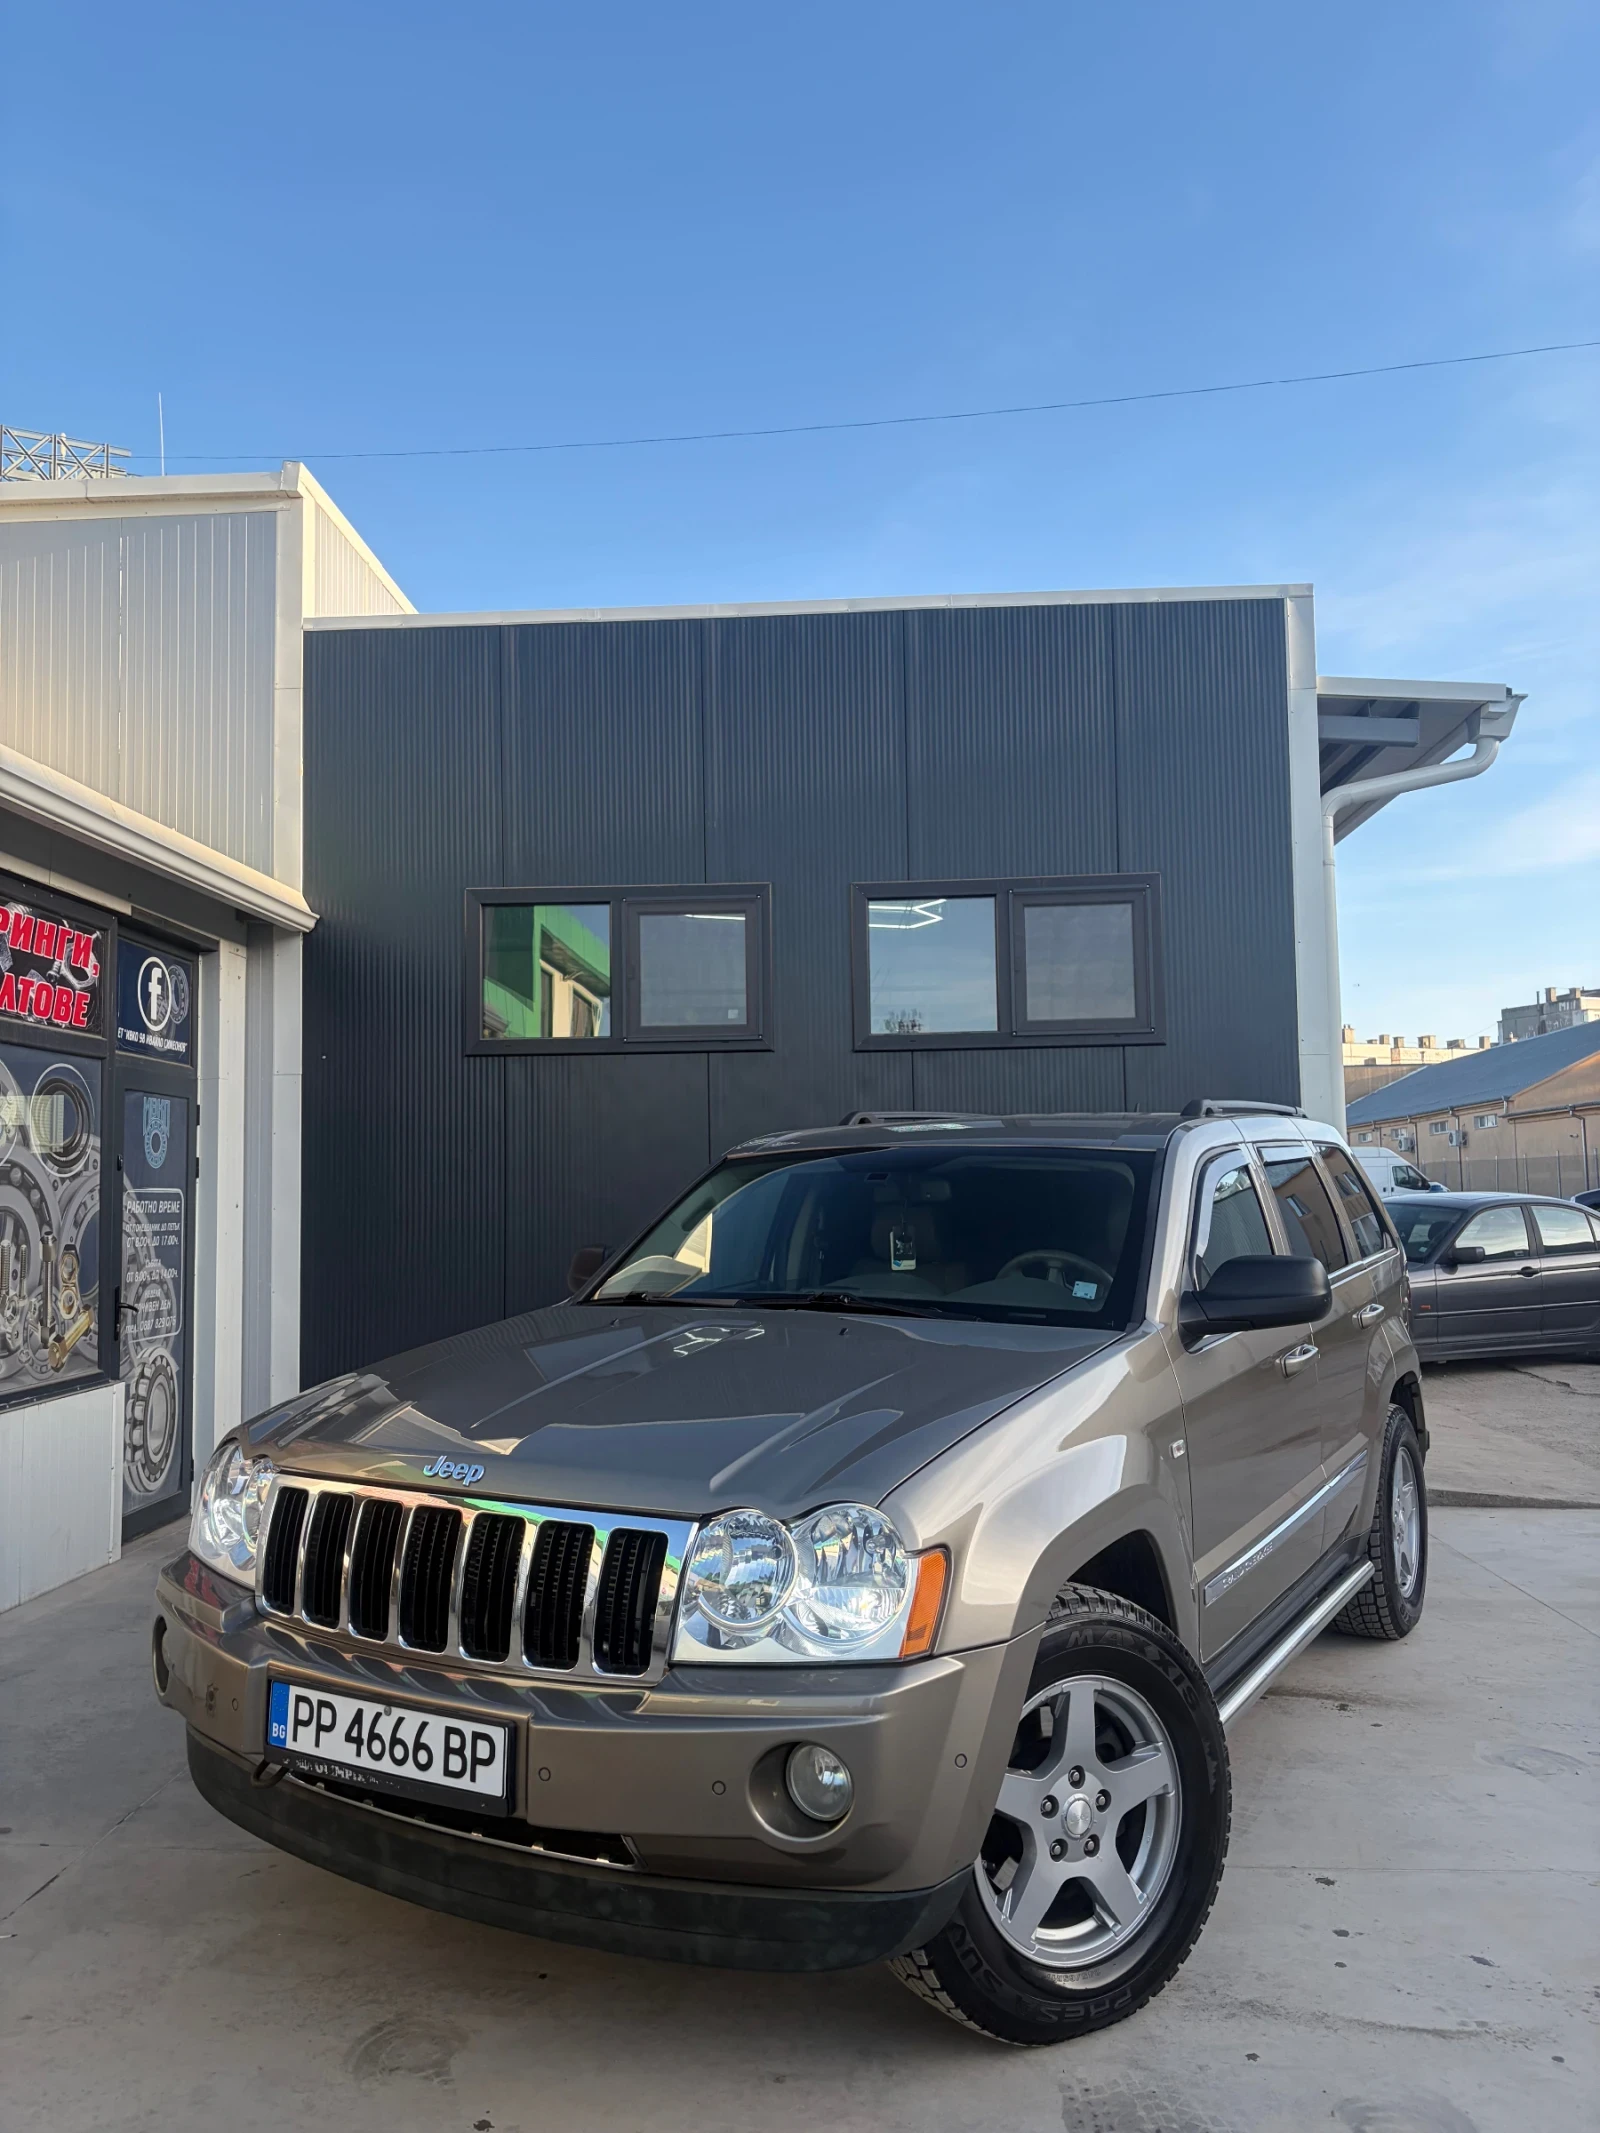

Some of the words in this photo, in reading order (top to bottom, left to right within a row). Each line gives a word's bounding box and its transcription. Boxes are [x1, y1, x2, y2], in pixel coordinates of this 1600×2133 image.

[126, 1200, 158, 1214] РАБОТНО
[158, 1200, 181, 1213] ВРЕМЕ
[126, 1236, 135, 1248] ОТ
[152, 1235, 160, 1247] ДО
[126, 1272, 134, 1283] ОТ
[423, 1455, 485, 1487] Jeep
[1066, 1628, 1200, 1712] MAXXIS
[272, 1722, 286, 1739] BG
[344, 1707, 434, 1772] 4666
